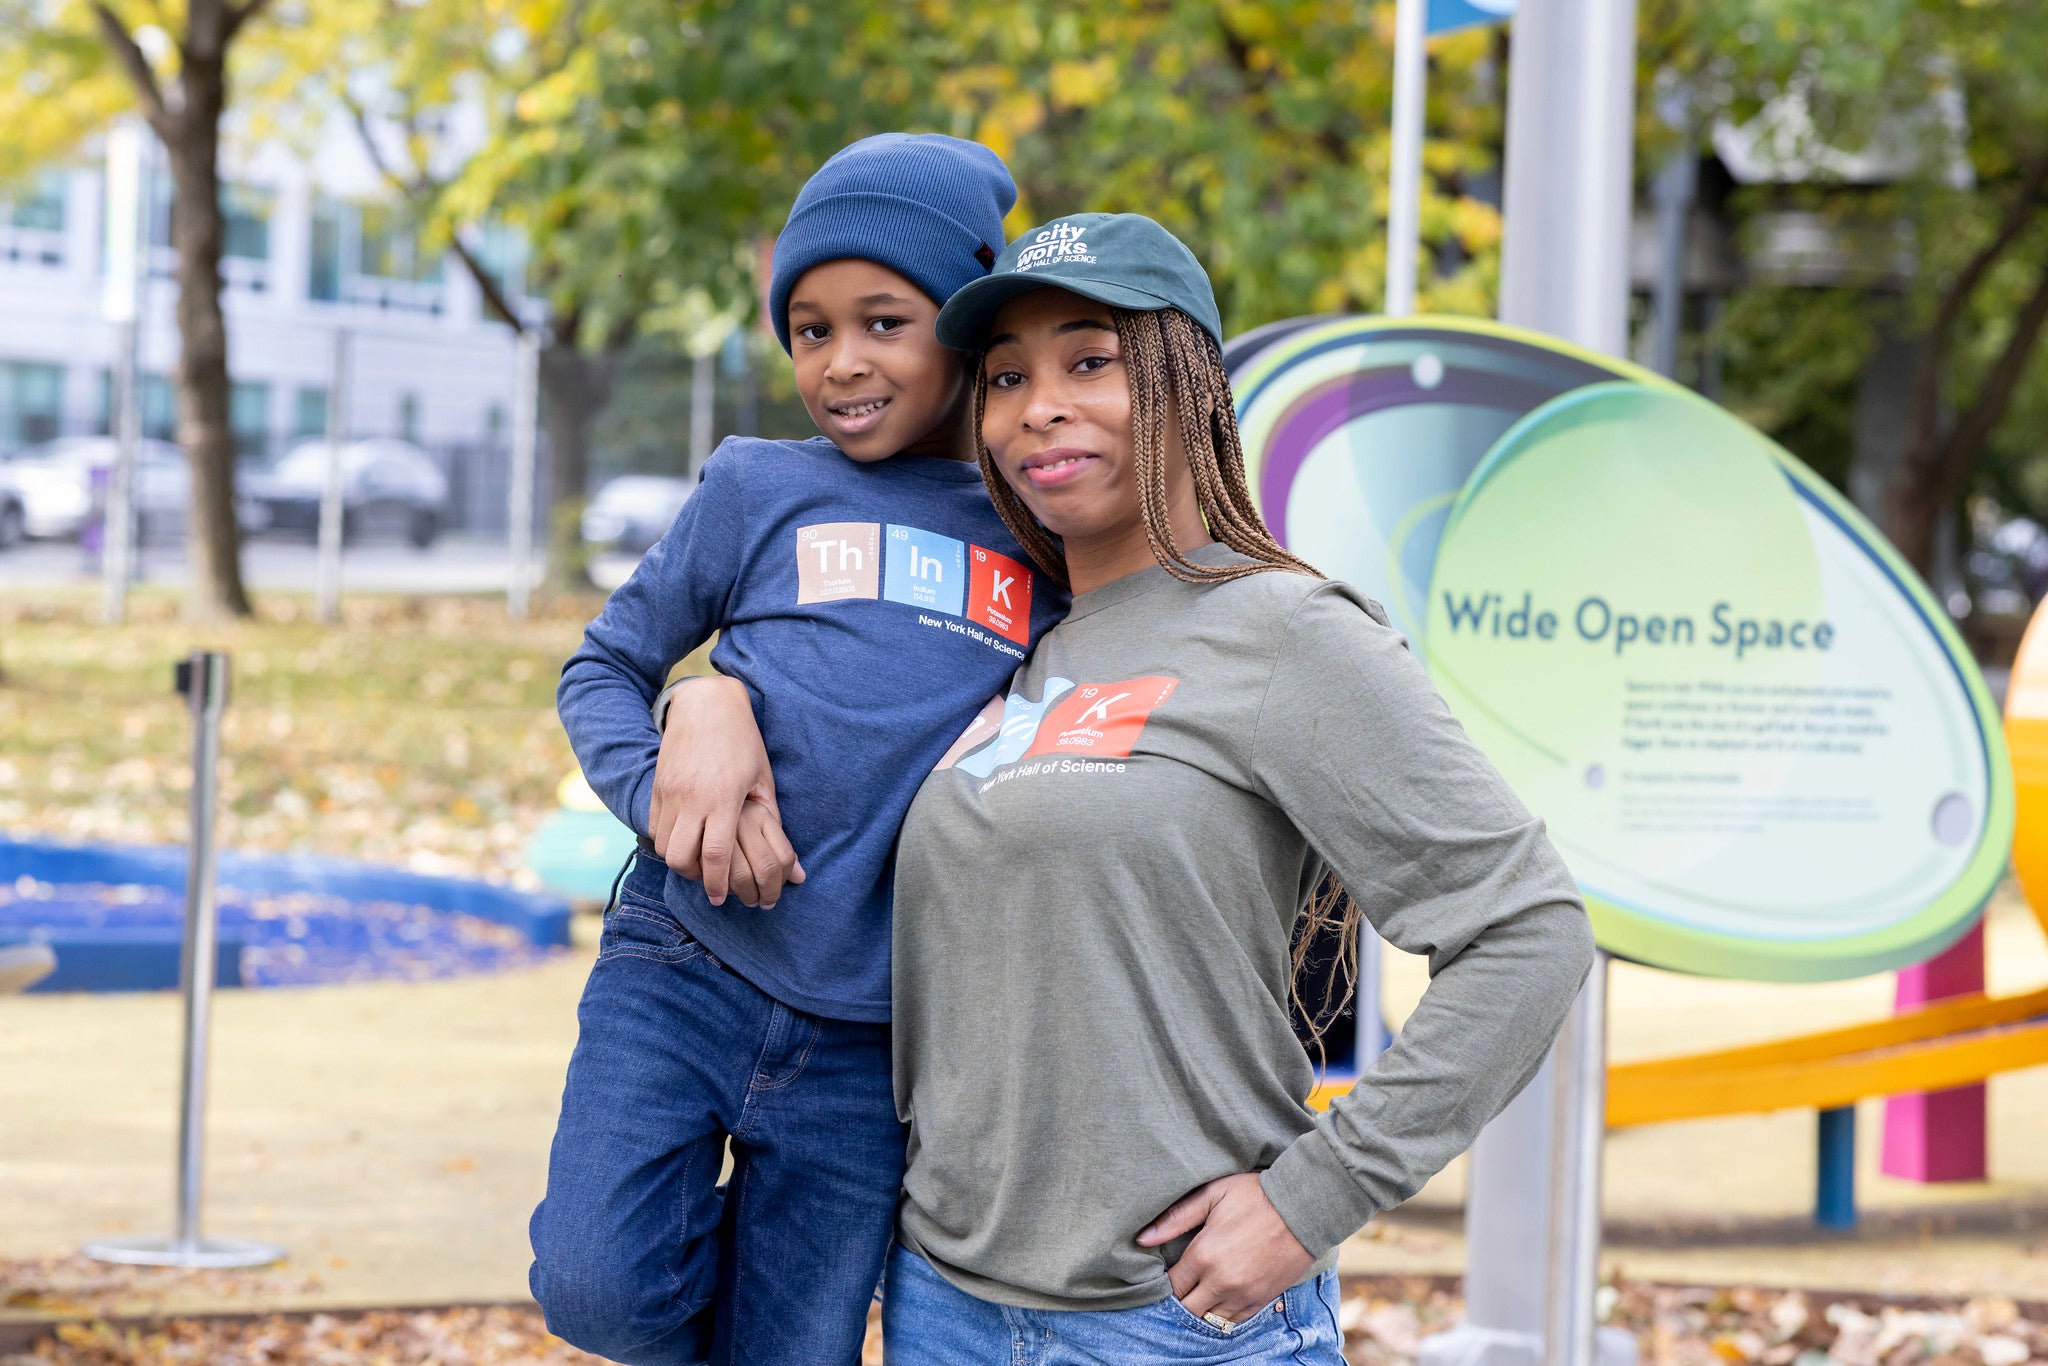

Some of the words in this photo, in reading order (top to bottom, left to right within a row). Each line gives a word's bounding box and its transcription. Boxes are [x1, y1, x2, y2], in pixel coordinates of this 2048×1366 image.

[1036, 223, 1086, 243] city
[1016, 239, 1088, 267] works
[1052, 256, 1064, 264] OF
[1063, 255, 1097, 264] SCIENCE
[801, 529, 817, 541] 90
[891, 529, 909, 540] 49
[810, 540, 863, 573] Th
[910, 545, 943, 582] In
[974, 549, 987, 562] 19
[992, 569, 1015, 610] K
[919, 614, 943, 628] New
[944, 620, 966, 634] York
[967, 627, 984, 642] Hall
[984, 636, 994, 646] of
[993, 640, 1025, 661] Science
[1443, 590, 1558, 640] Wide
[1575, 596, 1695, 655] Open
[1710, 602, 1836, 660] Space
[1079, 688, 1098, 699] 19
[1075, 692, 1133, 724] K
[997, 769, 1016, 784] York
[1015, 762, 1042, 778] Hall
[1041, 761, 1058, 774] of
[1060, 759, 1126, 773] Science
